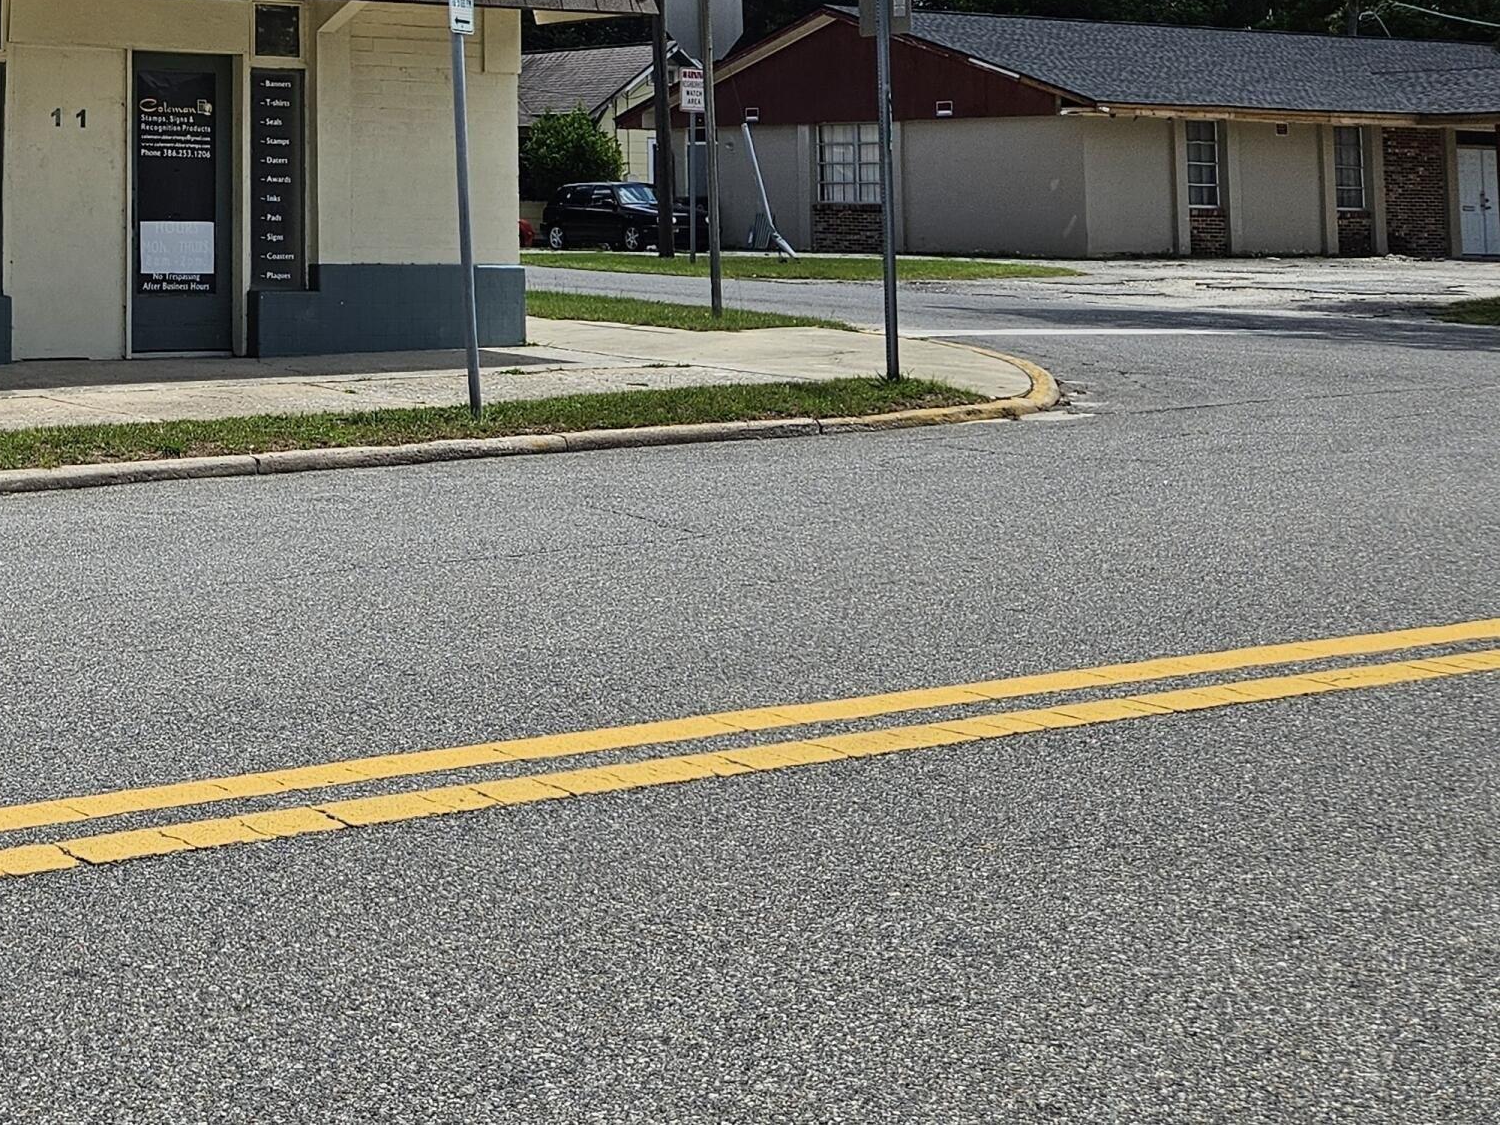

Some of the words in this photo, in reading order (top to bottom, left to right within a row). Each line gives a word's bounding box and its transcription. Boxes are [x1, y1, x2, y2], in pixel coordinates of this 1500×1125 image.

[265, 80, 291, 88] Banners
[139, 98, 197, 114] Coleman
[265, 98, 290, 107] T-shirts
[169, 115, 188, 124] Signs
[189, 115, 194, 123] &
[265, 118, 282, 126] Seals
[141, 123, 180, 133] Recognition
[182, 124, 211, 133] Products
[266, 137, 290, 145] Stamps
[141, 148, 161, 156] Phone
[163, 149, 211, 158] 386.253.1206
[266, 156, 288, 164] Daters
[266, 214, 282, 222] Pads
[266, 234, 284, 242] Signs
[152, 272, 163, 280] No
[165, 273, 200, 281] Trespassing
[266, 272, 291, 280] Plaques
[142, 282, 161, 290] After
[162, 282, 188, 290] Business
[190, 282, 210, 290] Hours
